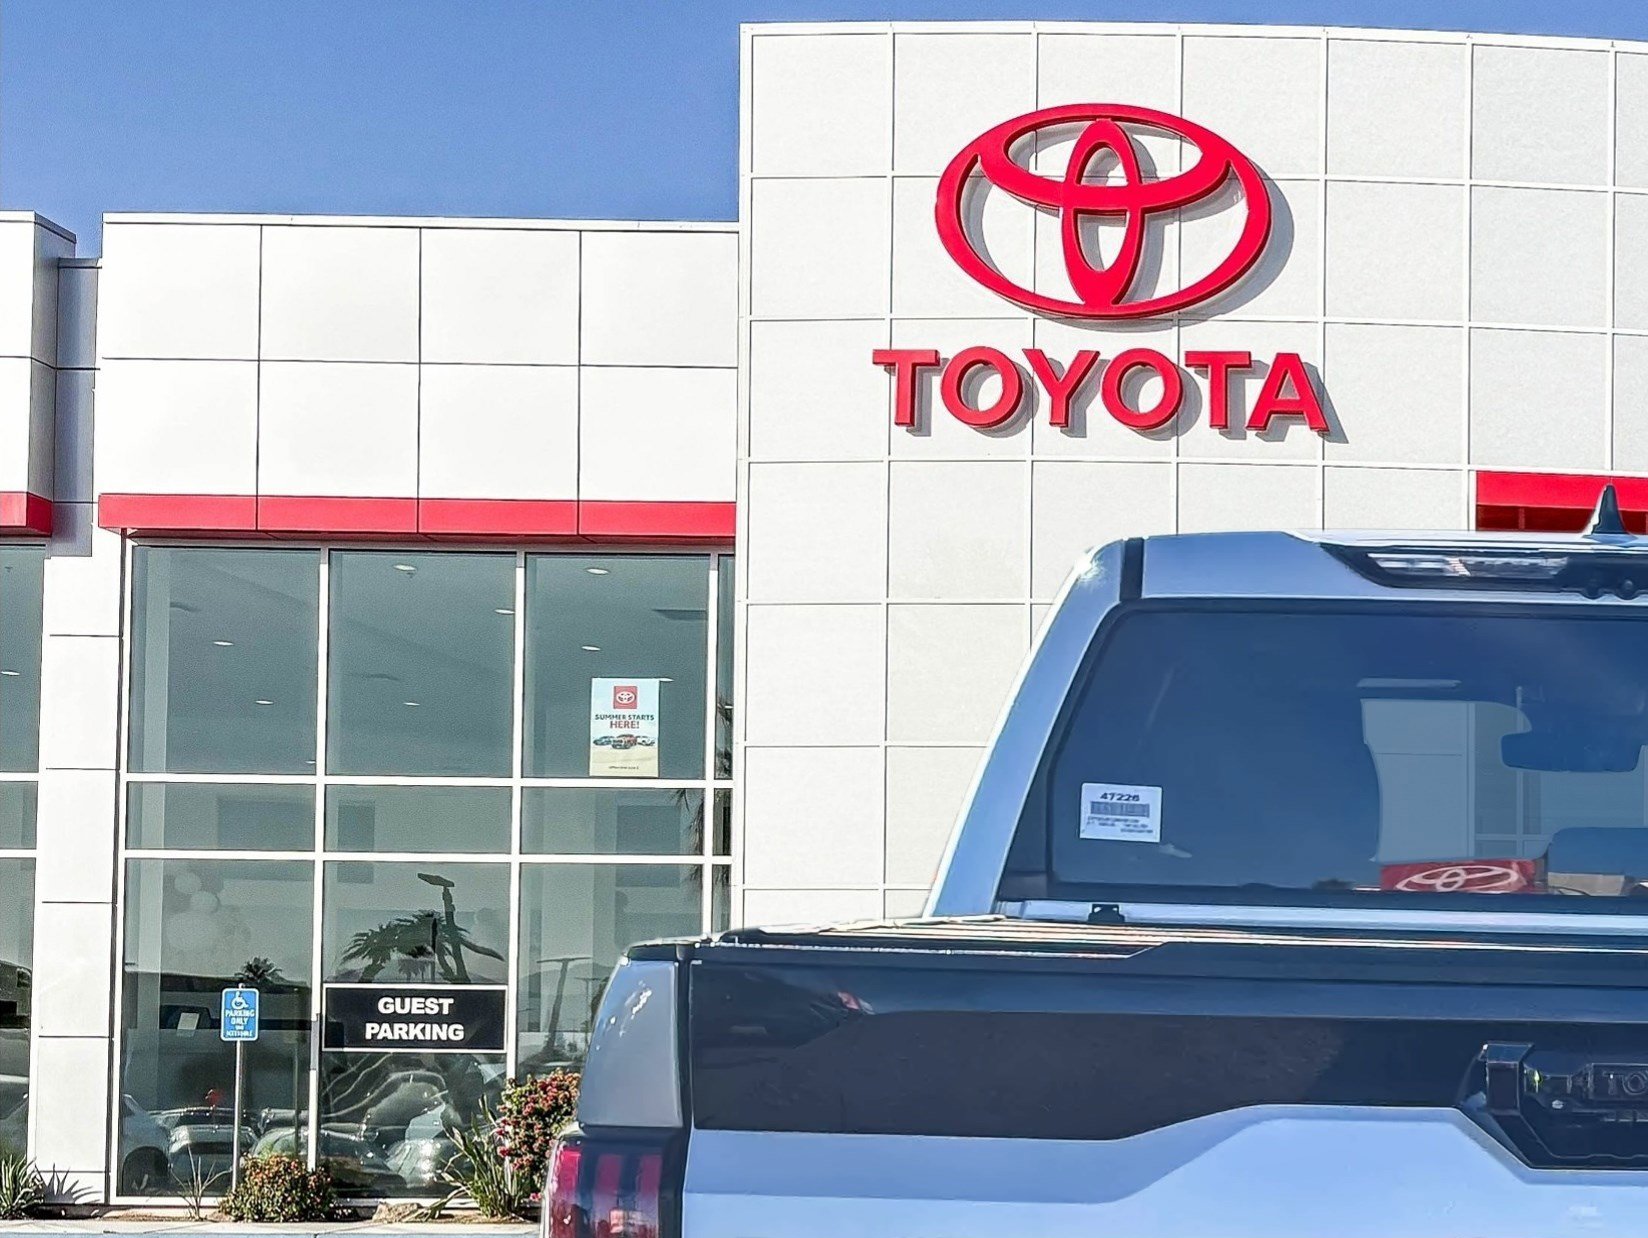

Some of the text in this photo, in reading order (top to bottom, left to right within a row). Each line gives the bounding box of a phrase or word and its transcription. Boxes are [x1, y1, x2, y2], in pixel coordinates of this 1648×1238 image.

[872, 346, 1332, 432] TOYOTA
[609, 720, 640, 729] HERE!
[377, 996, 454, 1015] GUEST
[365, 1022, 465, 1041] PARKING
